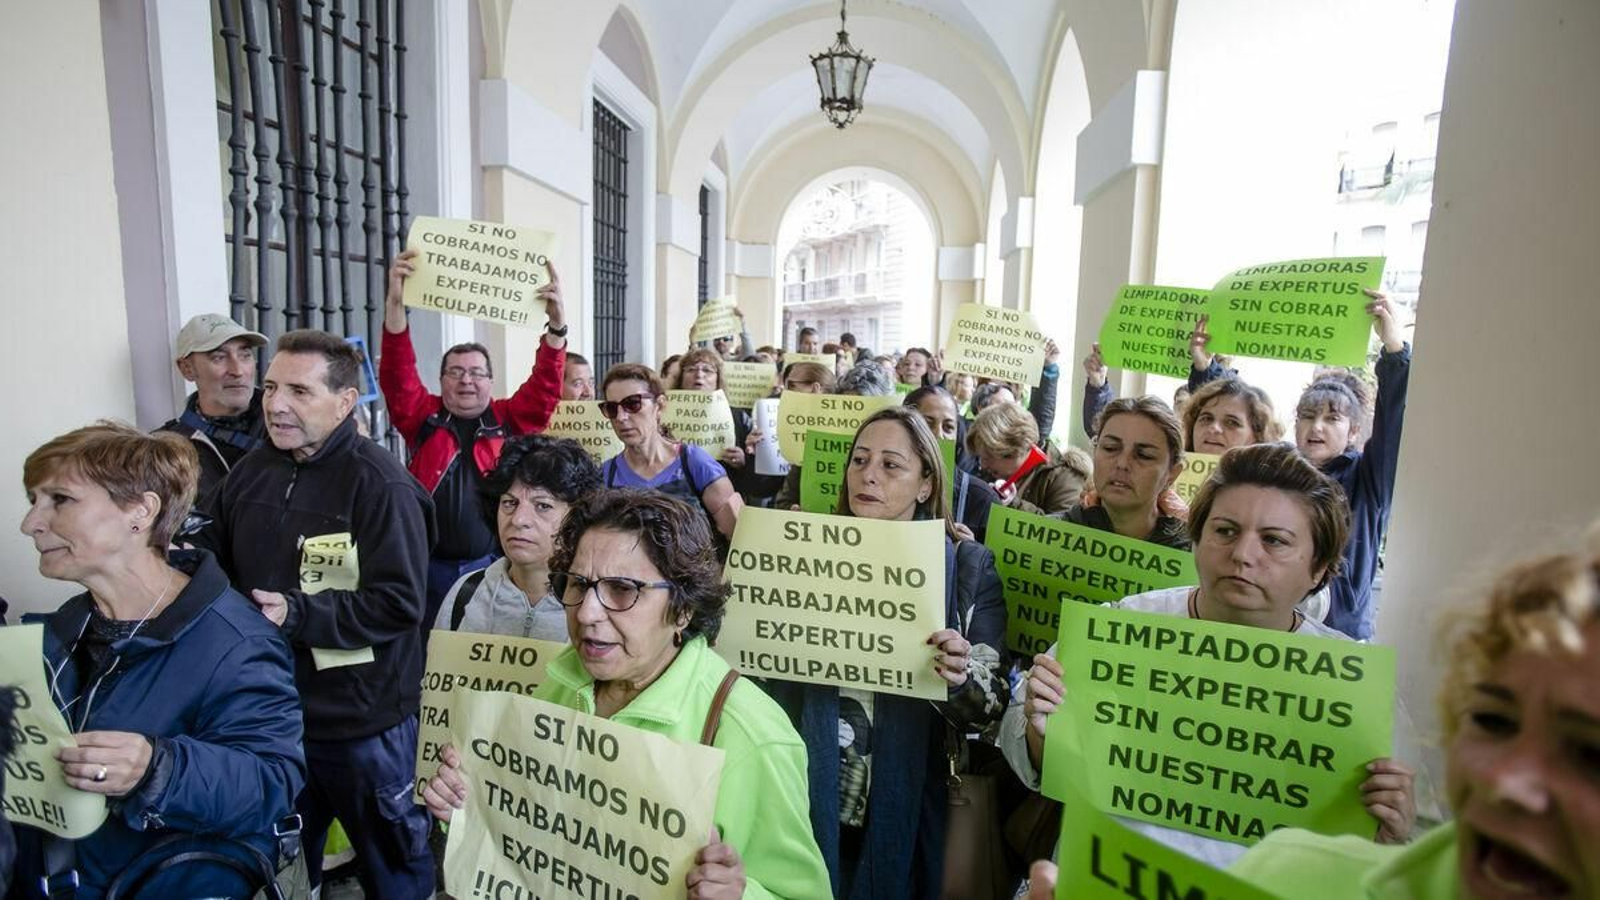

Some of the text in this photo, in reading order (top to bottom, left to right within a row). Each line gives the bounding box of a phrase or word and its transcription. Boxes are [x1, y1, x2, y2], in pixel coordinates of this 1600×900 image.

[468, 223, 517, 240] SI NO
[422, 232, 548, 267] COBRAMOS NO
[426, 251, 539, 285] TRABAJAMOS
[1235, 262, 1368, 277] LIMPIADORAS
[436, 275, 523, 302] EXPERTUS
[1123, 289, 1209, 305] LIMPIADORA
[1230, 280, 1359, 295] DE EXPERTUS
[422, 293, 529, 324] !!CULPABLE!!
[985, 309, 1020, 322] SI NO
[1119, 304, 1136, 316] DE
[1229, 298, 1348, 317] SIN COBRAR
[957, 319, 1042, 341] COBRAMOS NO
[1117, 322, 1142, 335] SIN
[1234, 320, 1335, 340] NUESTRAS
[958, 333, 1035, 354] TRABAJAMOS
[1121, 340, 1194, 361] NUESTRAS
[1235, 341, 1327, 361] NOMINAS
[964, 349, 1023, 367] EXPERTUS
[1122, 358, 1190, 378] NOMINAS
[953, 362, 1028, 382] !!CULPABLE!!
[566, 405, 585, 415] NO
[676, 409, 708, 418] PAGA
[821, 398, 865, 411] SI NO
[549, 421, 591, 431] AMOS
[786, 414, 864, 429] COBRAMO
[816, 460, 836, 474] DE
[820, 482, 842, 495] SI
[783, 521, 862, 547] SI NO
[1003, 518, 1182, 578] LIMPIADORAS
[728, 549, 926, 589] COBRAMOS NO
[1002, 548, 1032, 570] DE
[1006, 577, 1048, 599] SIN
[733, 584, 917, 622] TRABAJAMOS
[755, 619, 895, 654] EXPERTUS
[469, 642, 538, 667] SI NO
[1087, 618, 1365, 682] LIMPIADORAS
[739, 650, 914, 690] !!CULPABLE!!
[1090, 659, 1353, 728] DE EXPERTUS
[533, 713, 620, 762] SI NO
[1094, 701, 1336, 772] SIN COBRAR
[1108, 744, 1309, 809] NUESTRAS
[471, 738, 686, 838] COBRAMOS NO
[484, 780, 671, 886] TRABAJAMOS
